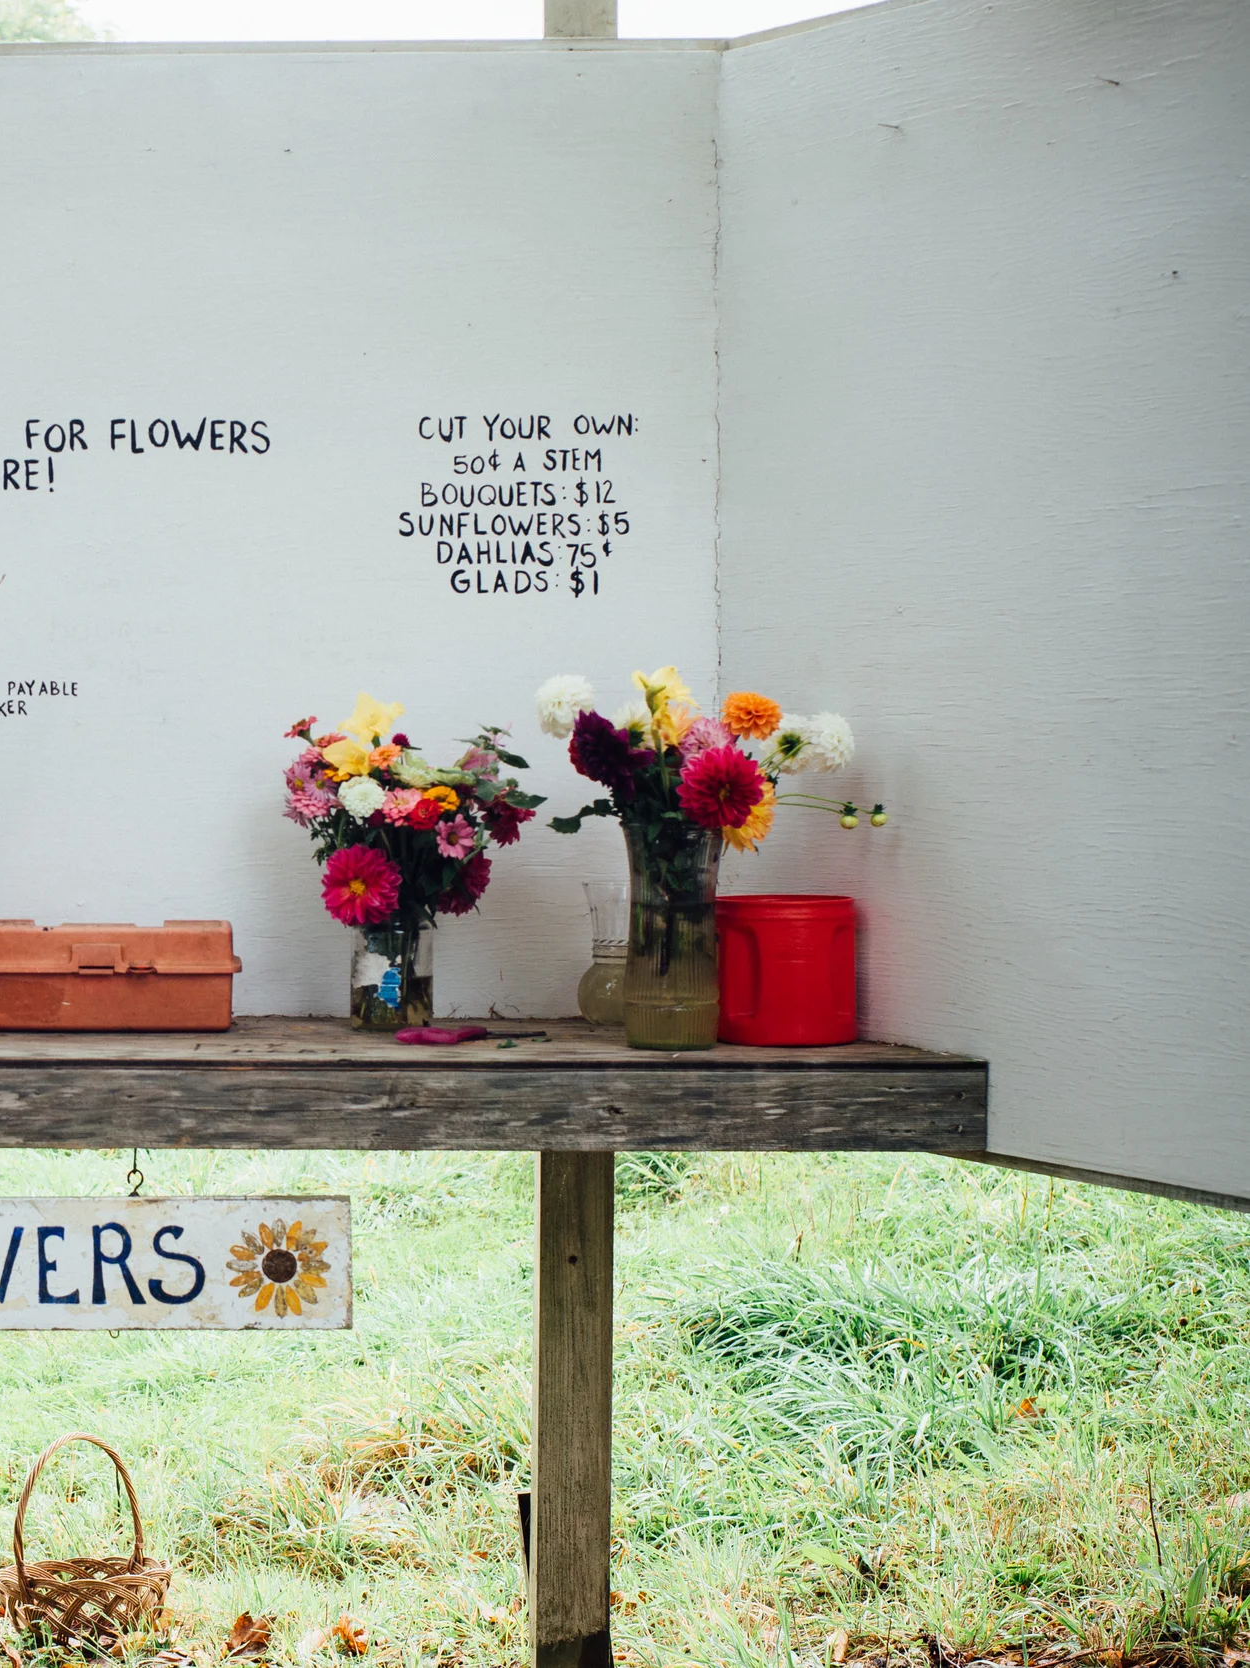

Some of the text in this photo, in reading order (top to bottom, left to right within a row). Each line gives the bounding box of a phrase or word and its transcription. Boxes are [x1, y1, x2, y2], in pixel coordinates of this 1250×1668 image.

[25, 418, 88, 454] FOR
[110, 417, 271, 455] FLOWERS
[418, 413, 639, 443] CUT YOUR OWN:
[453, 448, 602, 474] 50¢ A STEM
[421, 476, 616, 507] BOUQUETS: $12
[398, 510, 630, 538] SUNFLOWERS: $5
[436, 538, 614, 568] DAHLIAS: 75¢
[450, 565, 599, 598] GLADS: $1
[7, 679, 79, 697] PAYABLE
